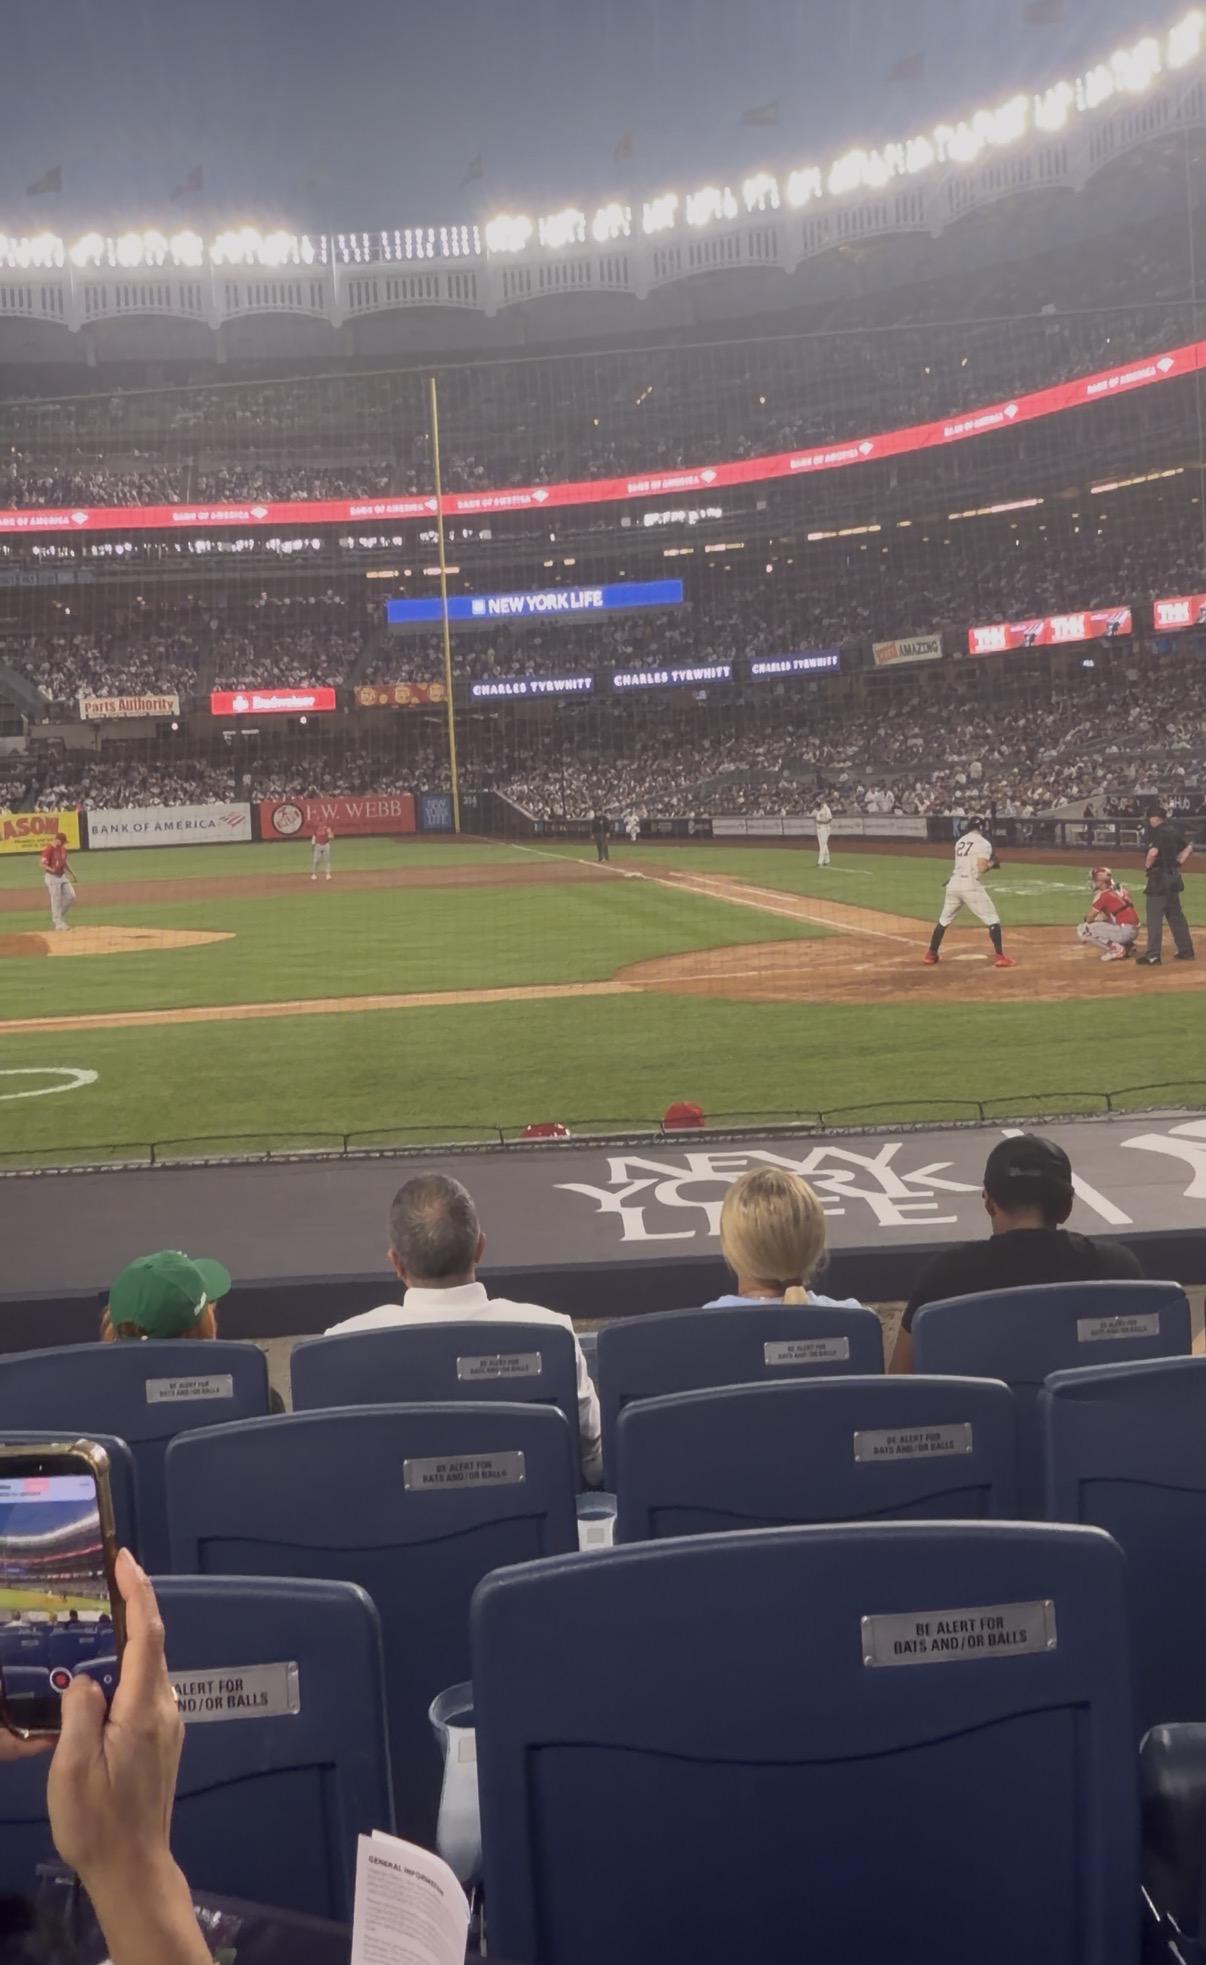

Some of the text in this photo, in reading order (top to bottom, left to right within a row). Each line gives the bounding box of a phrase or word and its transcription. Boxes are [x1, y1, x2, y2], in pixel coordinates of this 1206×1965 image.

[488, 590, 603, 614] NEW YORK LIFE
[613, 665, 731, 687] CHARLES TYRWHITT
[472, 677, 592, 696] CHARLES TYRWHITT
[85, 697, 174, 713] Parts Authority
[345, 800, 402, 817] WEBB
[0, 816, 59, 840] ASON
[92, 819, 216, 835] BANK OF AMERICA
[956, 841, 974, 857] 27
[915, 1616, 1004, 1637] BE ALERT FOR
[894, 1629, 1027, 1656] BATS AND/OR BALLS
[174, 1678, 244, 1696] ALERT FOR
[177, 1691, 268, 1713] ND/OR BALLS
[368, 1855, 402, 1872] GENERAL
